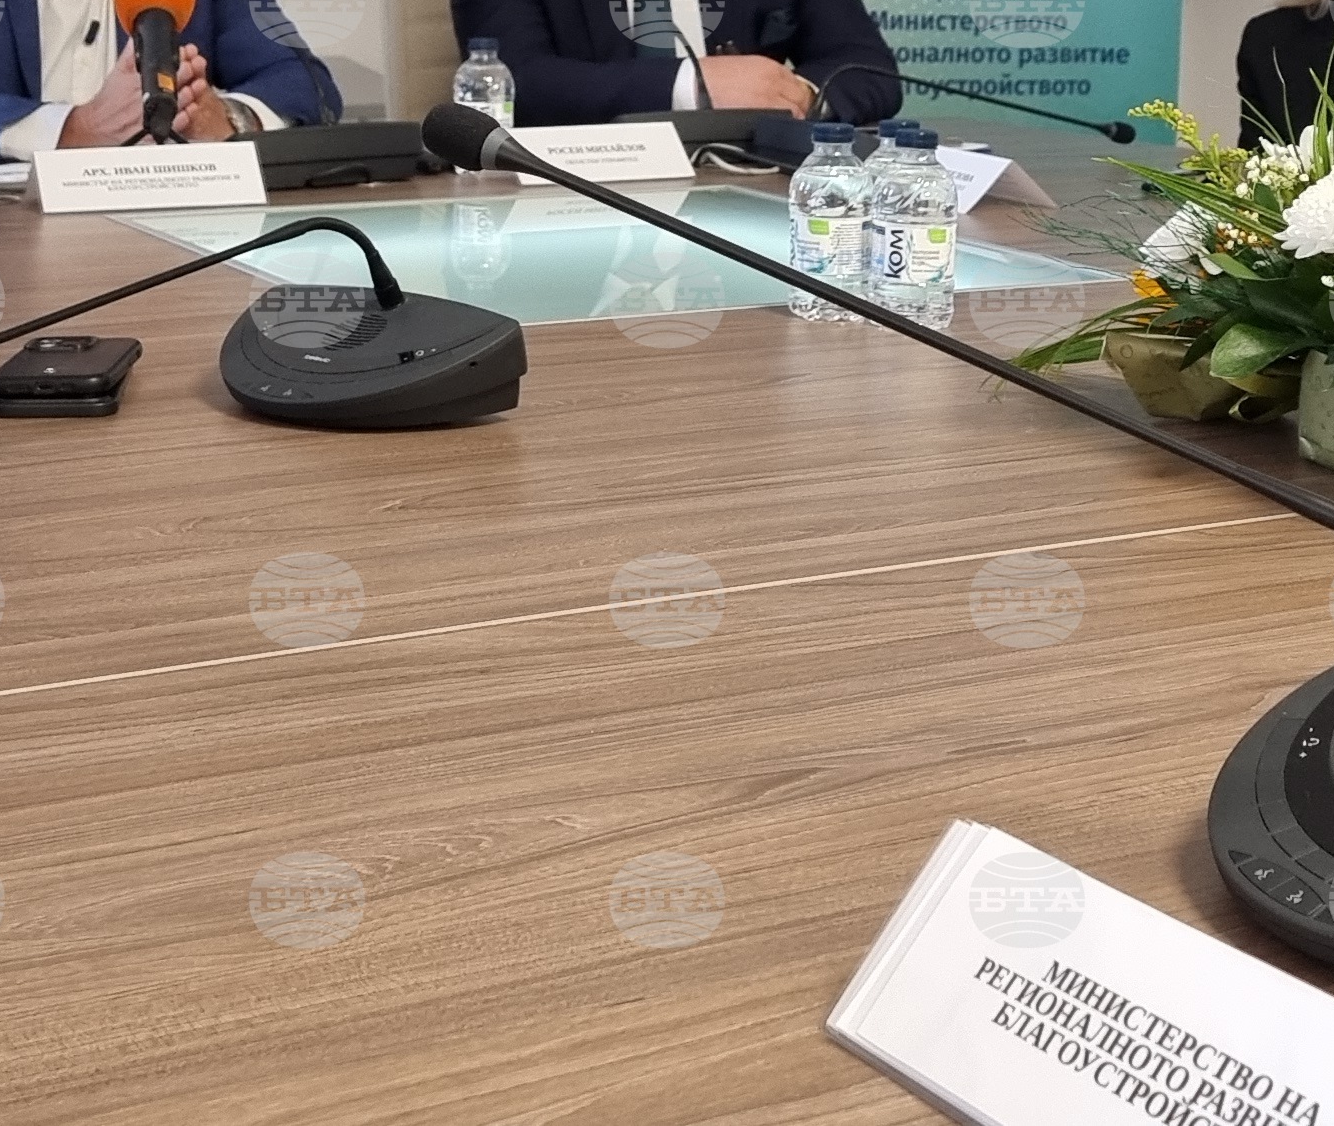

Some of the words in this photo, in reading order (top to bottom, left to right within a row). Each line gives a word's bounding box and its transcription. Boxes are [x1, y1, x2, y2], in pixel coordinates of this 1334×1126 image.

[871, 10, 1068, 36] Министерството
[892, 46, 1012, 64] оналното
[1018, 46, 1130, 68] развитие
[906, 73, 1091, 100] гоустройството
[114, 166, 151, 175] ИВАН
[973, 956, 1190, 1092] РЕГИОНАЛНОТО
[1041, 959, 1274, 1101] МИНИСТЕРСТВО
[1273, 1086, 1321, 1126] НА
